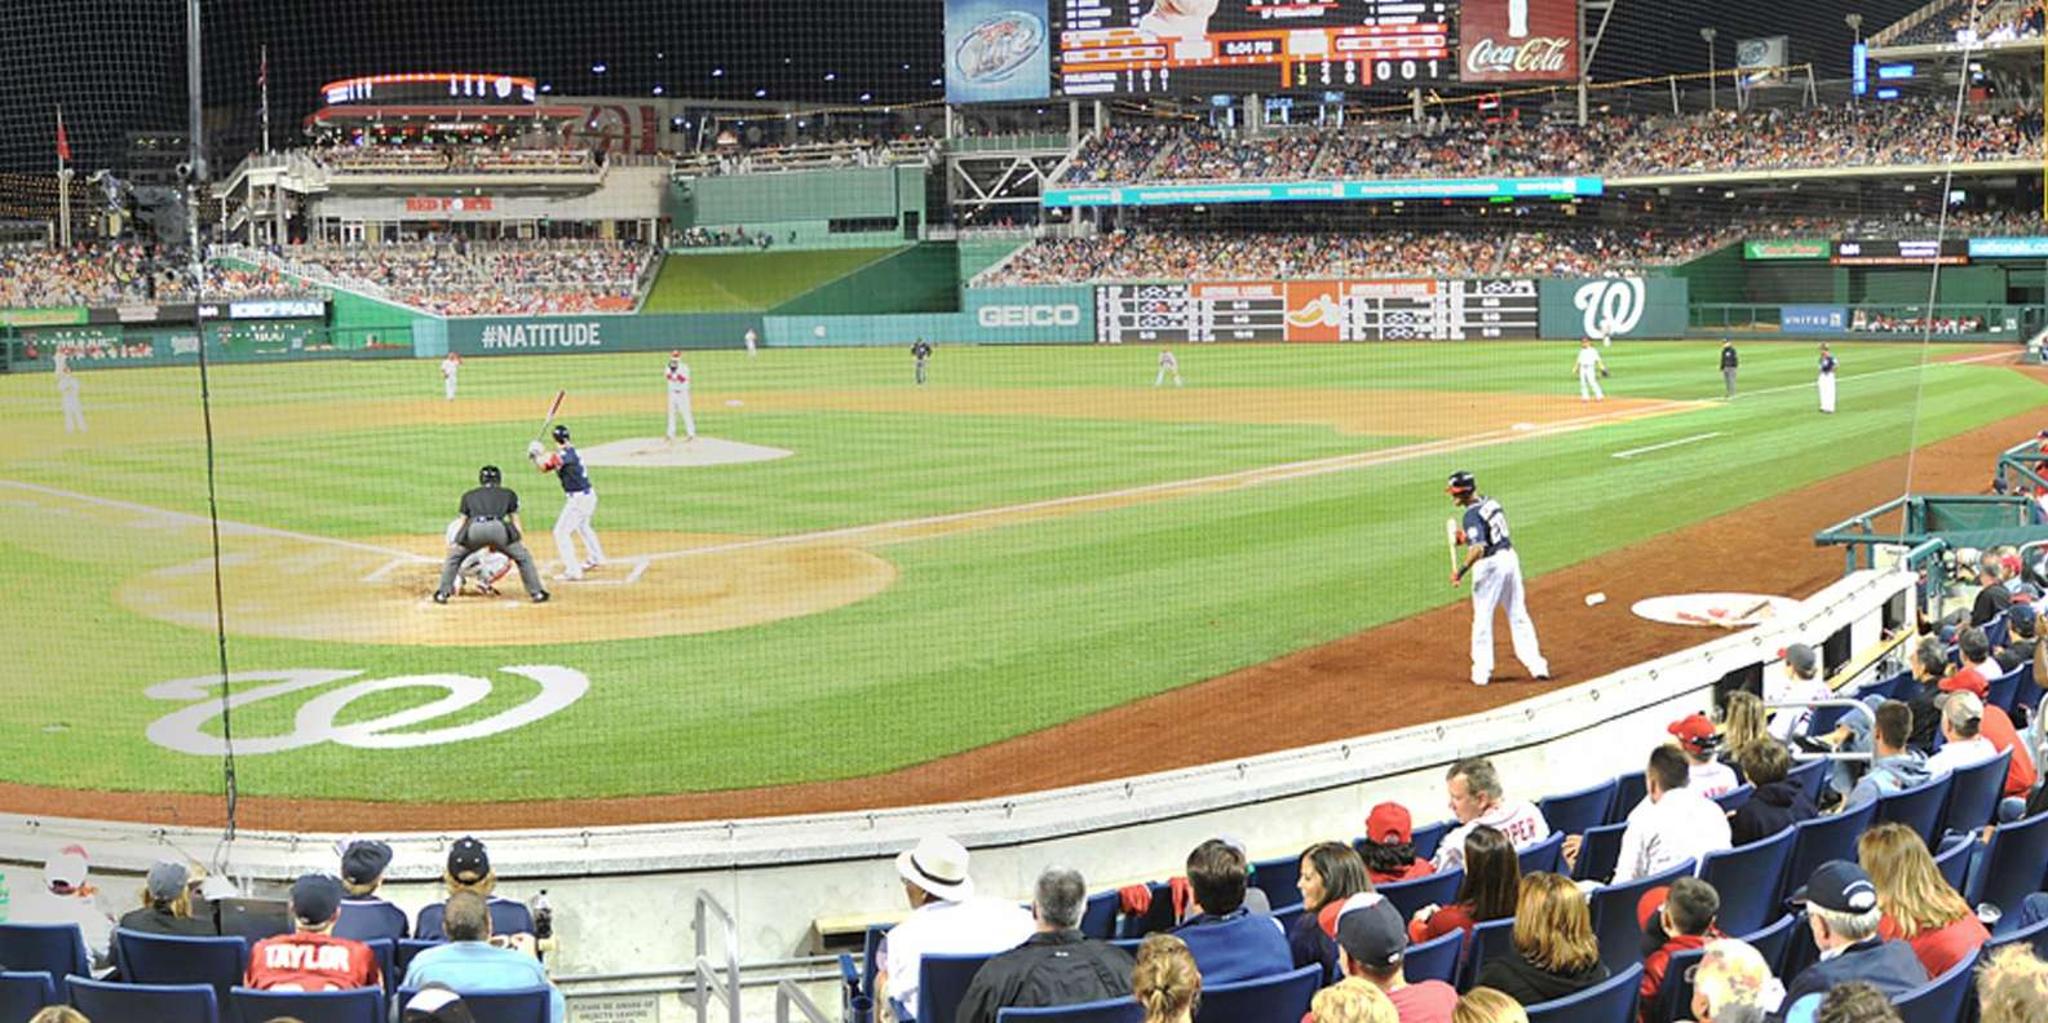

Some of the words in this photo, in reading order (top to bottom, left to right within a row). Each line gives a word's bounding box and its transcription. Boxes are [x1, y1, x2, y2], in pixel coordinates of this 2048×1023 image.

[1428, 59, 1438, 78] 1
[978, 304, 1080, 327] GEICO
[481, 323, 601, 348] #NATITUDE
[263, 943, 350, 973] TAYLOR
